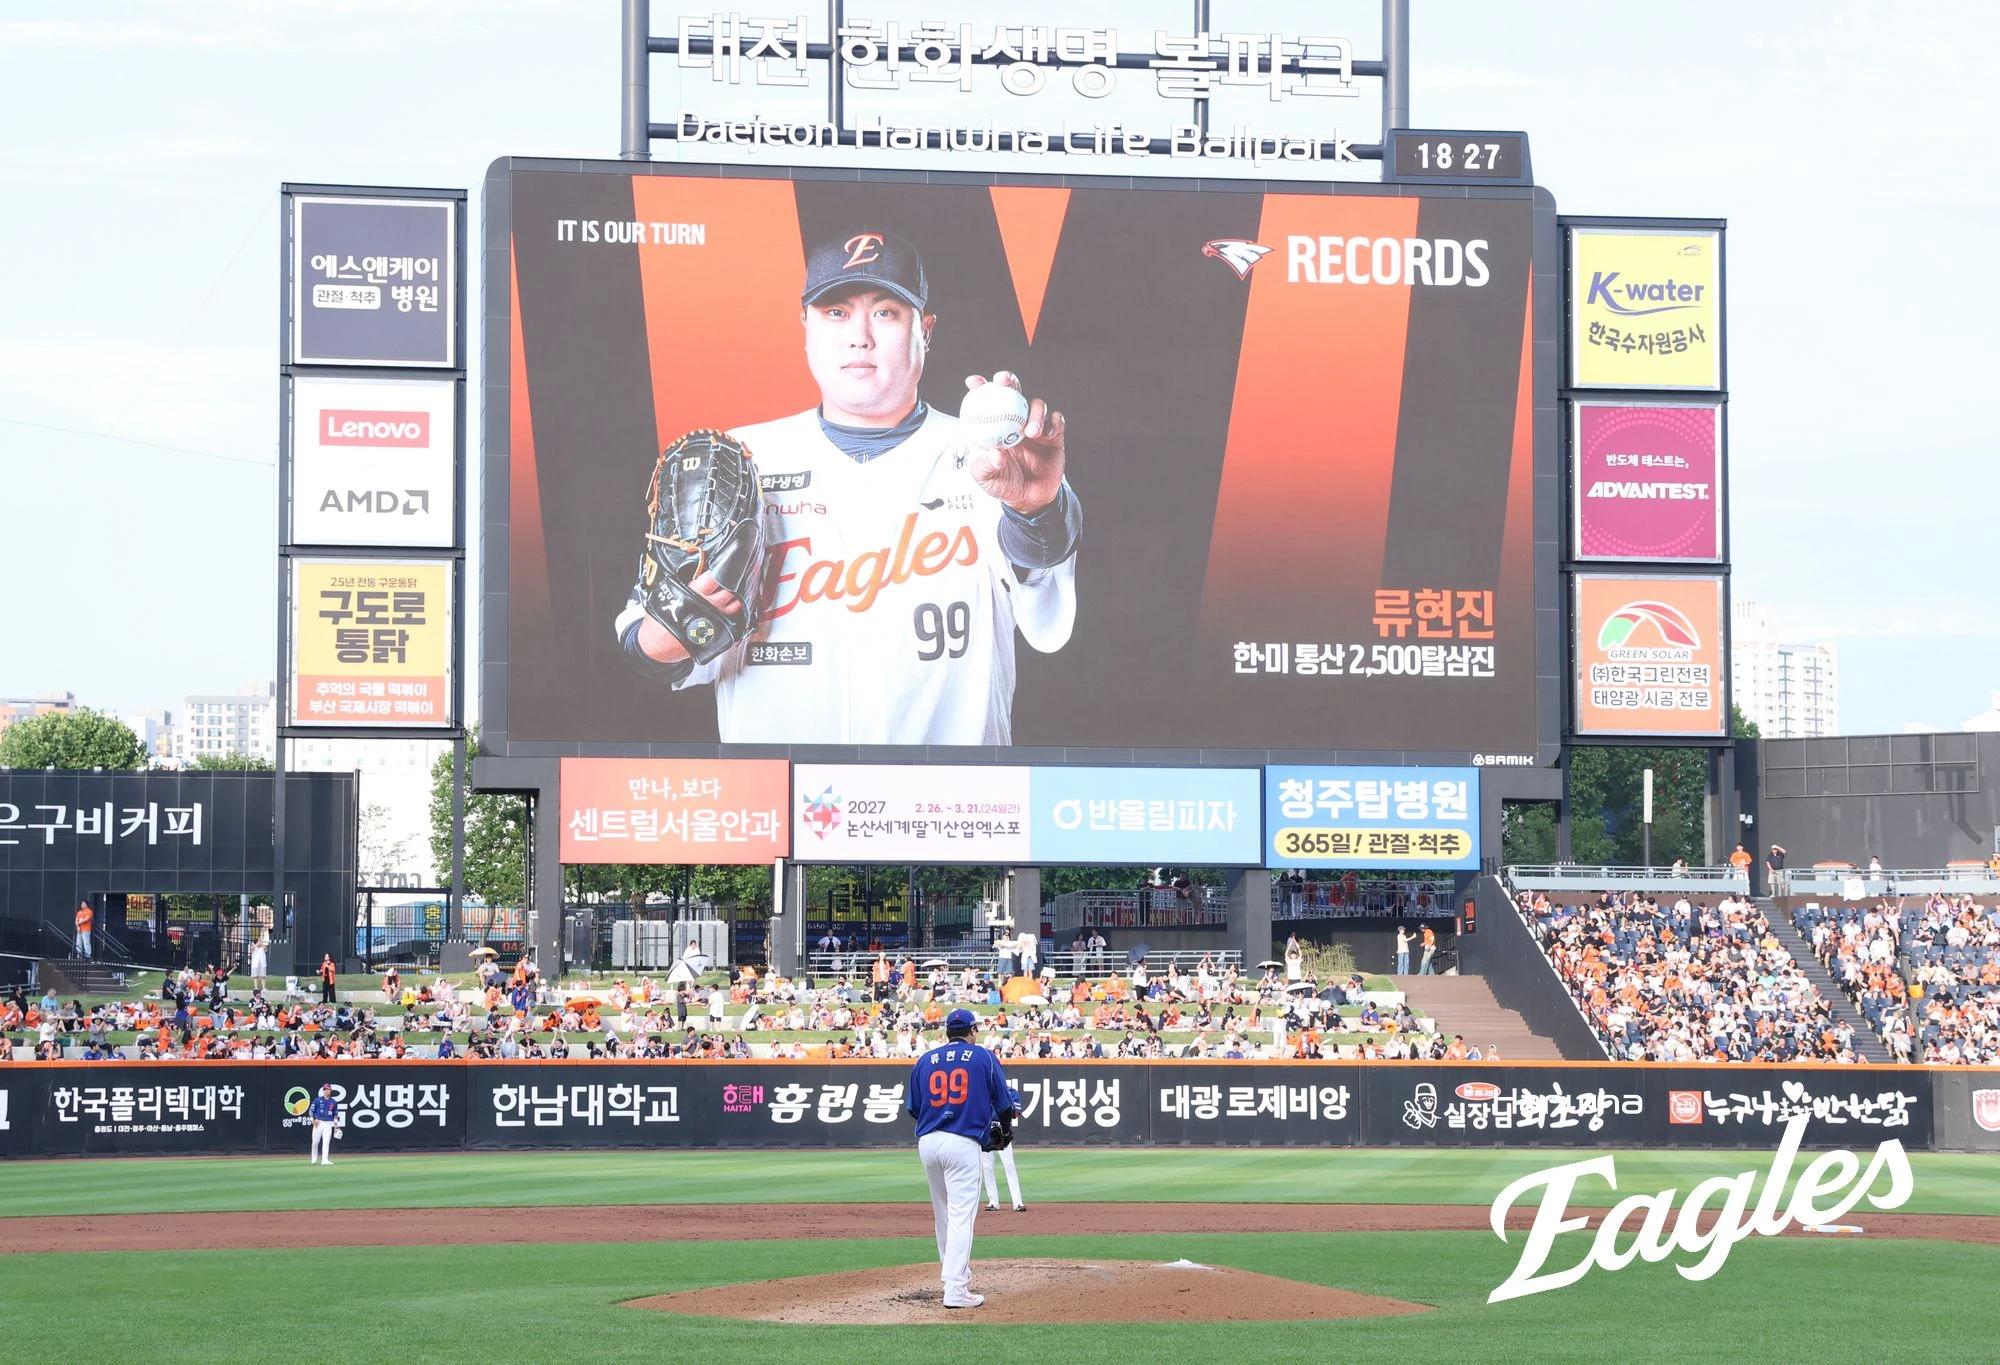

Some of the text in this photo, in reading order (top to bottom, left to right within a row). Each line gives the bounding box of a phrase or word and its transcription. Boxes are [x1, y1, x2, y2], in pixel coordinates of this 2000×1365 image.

[677, 12, 1360, 103] 대전 한화생명 볼파크
[676, 107, 1363, 169] Daejeon Hanwha Life Ballpark
[557, 219, 706, 246] IT IS OUR TURN
[310, 254, 438, 284] 에스앤케이
[1287, 234, 1491, 288] RECORDS
[391, 285, 438, 313] 병원
[1586, 271, 1705, 313] K-water
[1588, 321, 1706, 355] 한국수자원공사
[328, 416, 421, 439] Lenovo
[1605, 454, 1689, 469] 반도체 테스트는,
[319, 489, 399, 514] AMD
[330, 578, 355, 587] 25년
[357, 578, 376, 587] 전통
[757, 512, 979, 624] Eagles
[319, 590, 426, 625] 구도로
[1372, 588, 1495, 639] 류현진
[335, 629, 409, 663] 통닭
[913, 600, 971, 662] 99
[751, 647, 808, 663] 한화손보
[1294, 643, 1346, 675] 통산
[1349, 644, 1495, 678] 2,500탈삼진
[1610, 649, 1690, 659] GREEN SOLAR
[316, 682, 356, 696] 추억의
[1594, 690, 1709, 707] 태양광 시공 전문
[309, 700, 336, 714] 부산
[1485, 755, 1534, 766] SAMIK
[628, 777, 722, 801] 만나, 보다
[1278, 778, 1468, 820] 청주탑병원
[848, 801, 886, 814] 2027
[1088, 799, 1237, 832] 반올림피자
[569, 807, 782, 843] 센트럴서울안과
[847, 820, 1021, 838] 논산세계딸기산업엑스포
[1286, 832, 1460, 855] 365일! 관절·척추
[930, 1049, 973, 1065] 류현진
[929, 1067, 969, 1107] 99
[53, 1085, 245, 1122] 한국폴리텍대학
[317, 1083, 450, 1129] 음성명작
[492, 1083, 680, 1127] 한남대학교
[723, 1104, 752, 1112] HAITAI
[768, 1083, 905, 1124] 홈런볼
[1443, 1102, 1512, 1129] 실장님
